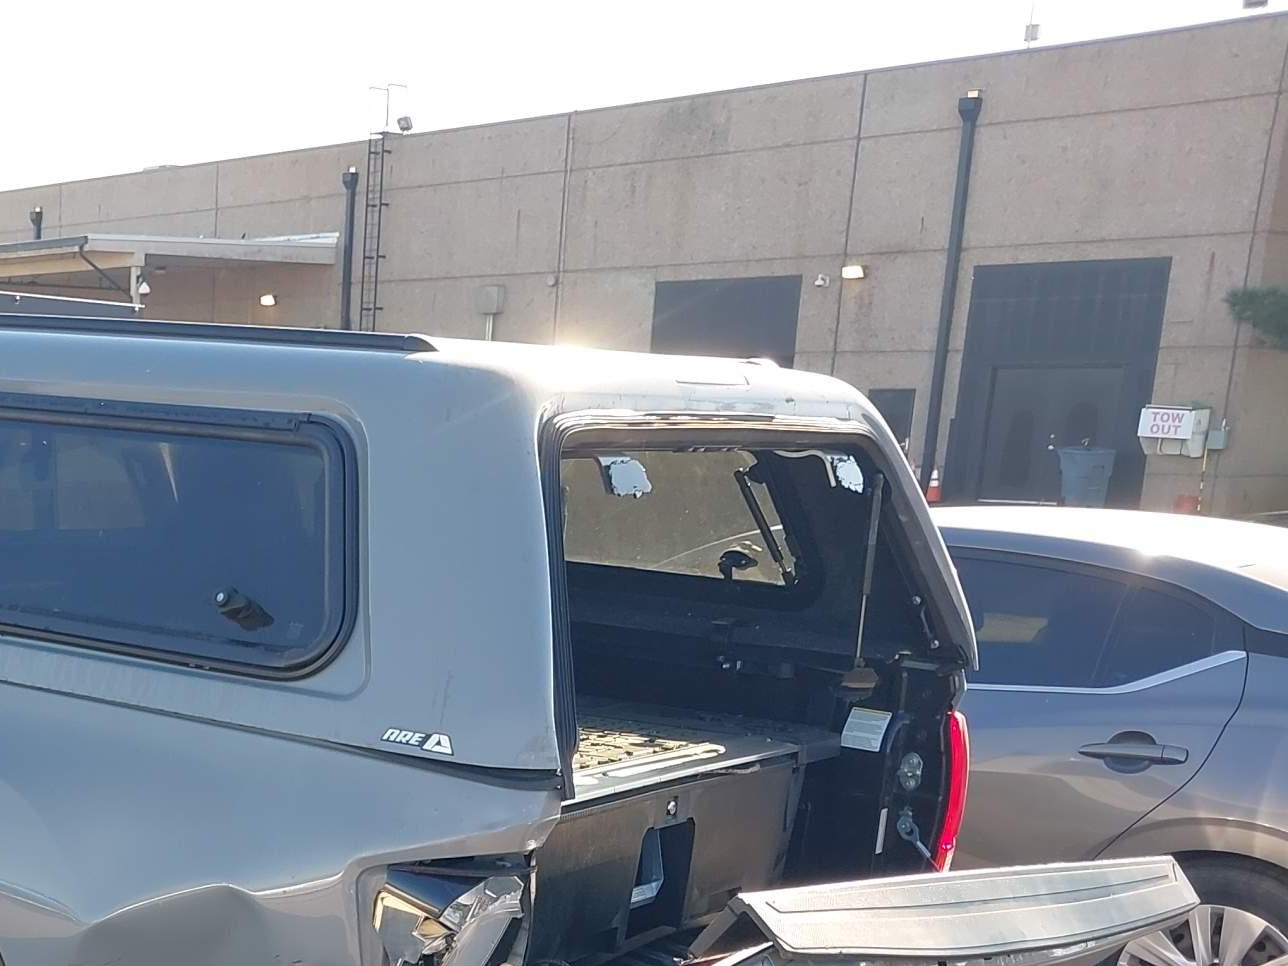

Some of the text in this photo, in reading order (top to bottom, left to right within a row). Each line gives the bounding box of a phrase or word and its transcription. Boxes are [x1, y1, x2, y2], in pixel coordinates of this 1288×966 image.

[1151, 411, 1185, 424] TOW
[1150, 423, 1182, 436] OUT
[381, 728, 426, 746] ARE
